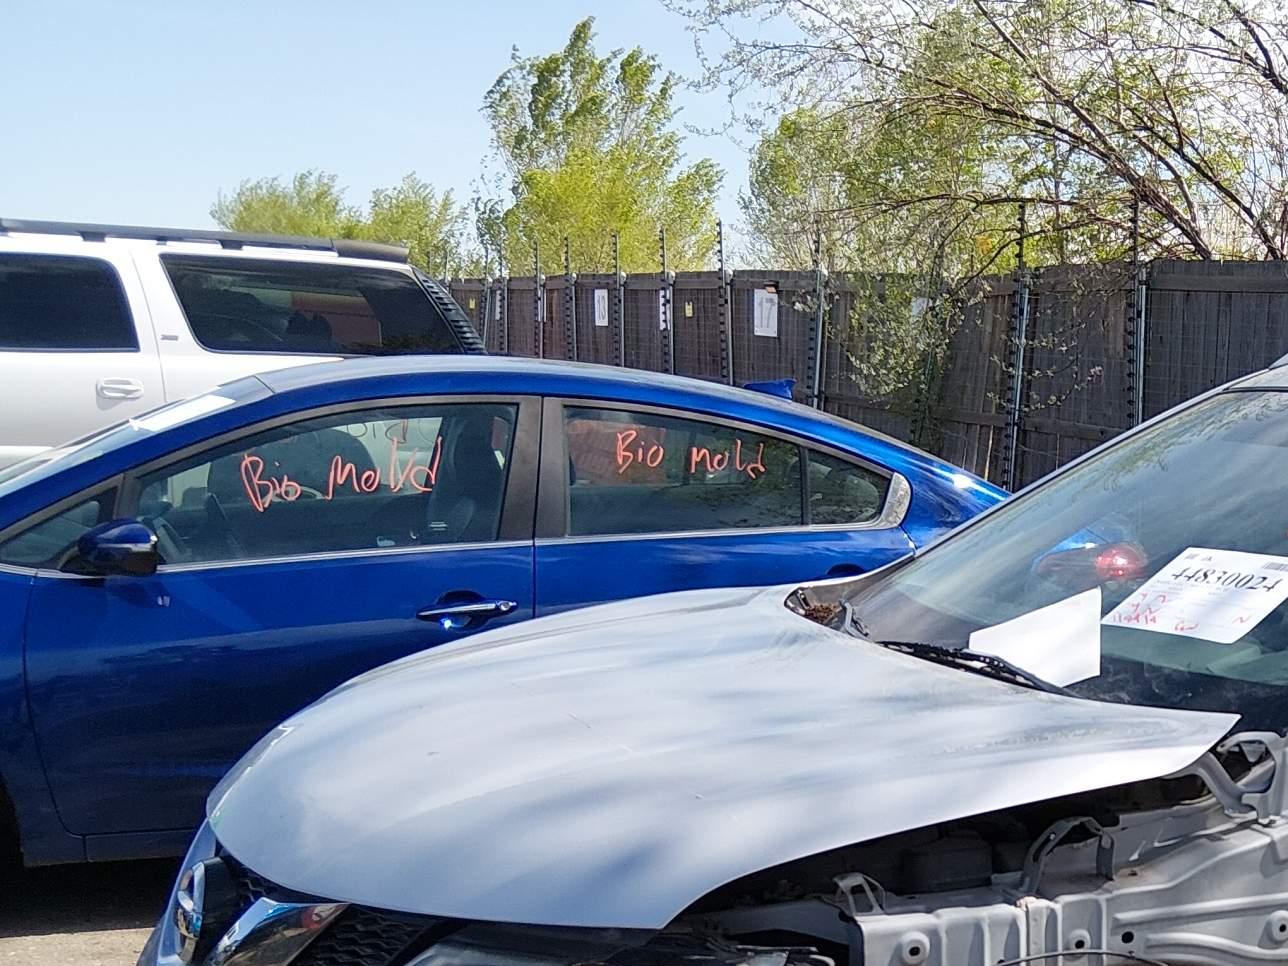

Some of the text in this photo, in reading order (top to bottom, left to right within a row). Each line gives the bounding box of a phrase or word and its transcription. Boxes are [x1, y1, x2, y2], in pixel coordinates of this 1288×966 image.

[616, 429, 664, 474] Bio
[240, 454, 302, 512] Bio
[1171, 567, 1284, 592] 44830024
